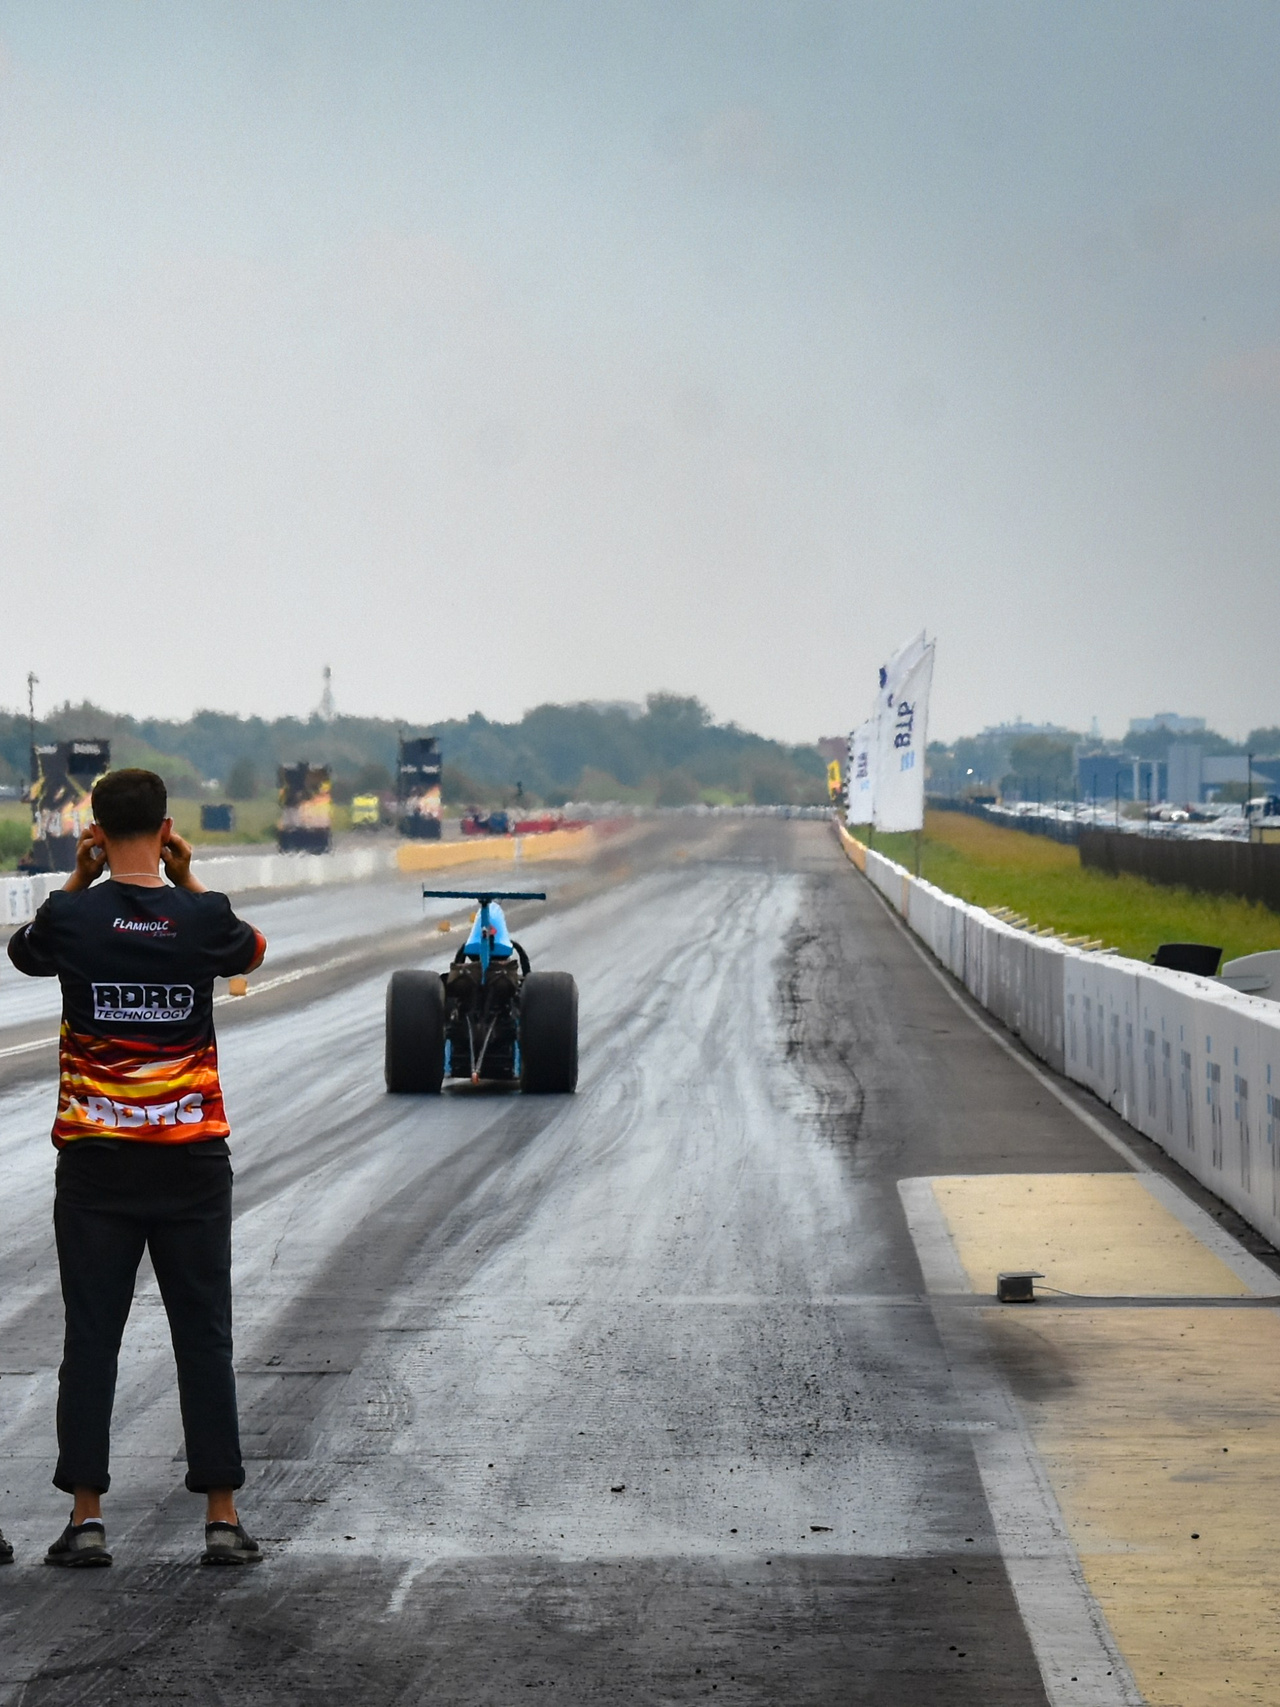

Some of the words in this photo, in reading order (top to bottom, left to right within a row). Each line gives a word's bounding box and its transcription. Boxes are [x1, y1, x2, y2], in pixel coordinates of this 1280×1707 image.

[113, 918, 170, 931] FLAMHOLC
[94, 985, 192, 1009] RDRC
[97, 1009, 190, 1020] TECHNOLOGY
